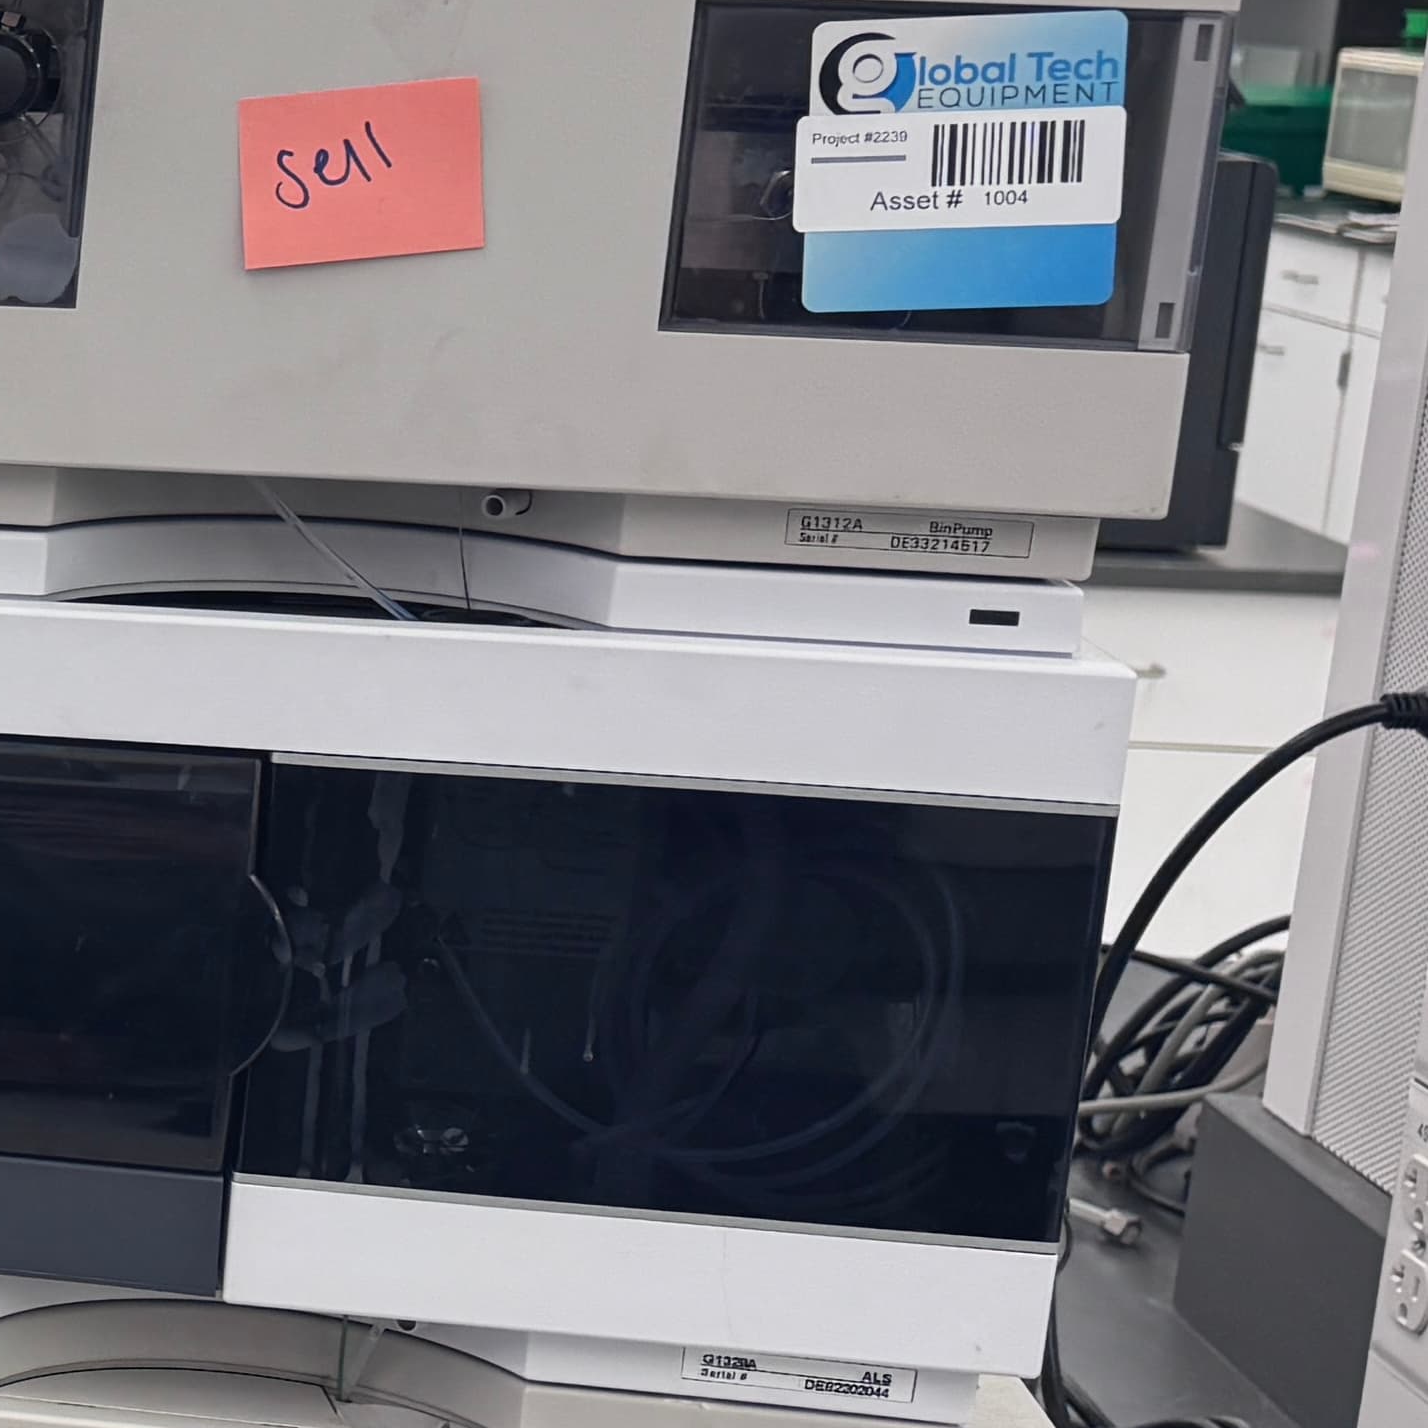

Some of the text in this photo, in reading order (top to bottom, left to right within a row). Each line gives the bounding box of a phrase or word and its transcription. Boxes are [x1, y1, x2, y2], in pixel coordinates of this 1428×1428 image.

[1026, 50, 1119, 82] Tech
[916, 80, 1119, 110] EQUIPMENT
[812, 130, 860, 148] Project
[869, 189, 1029, 212] Asset # 1004
[799, 532, 829, 544] Serial
[801, 516, 994, 539] G1312A BinPump
[862, 1371, 892, 1385] ALS
